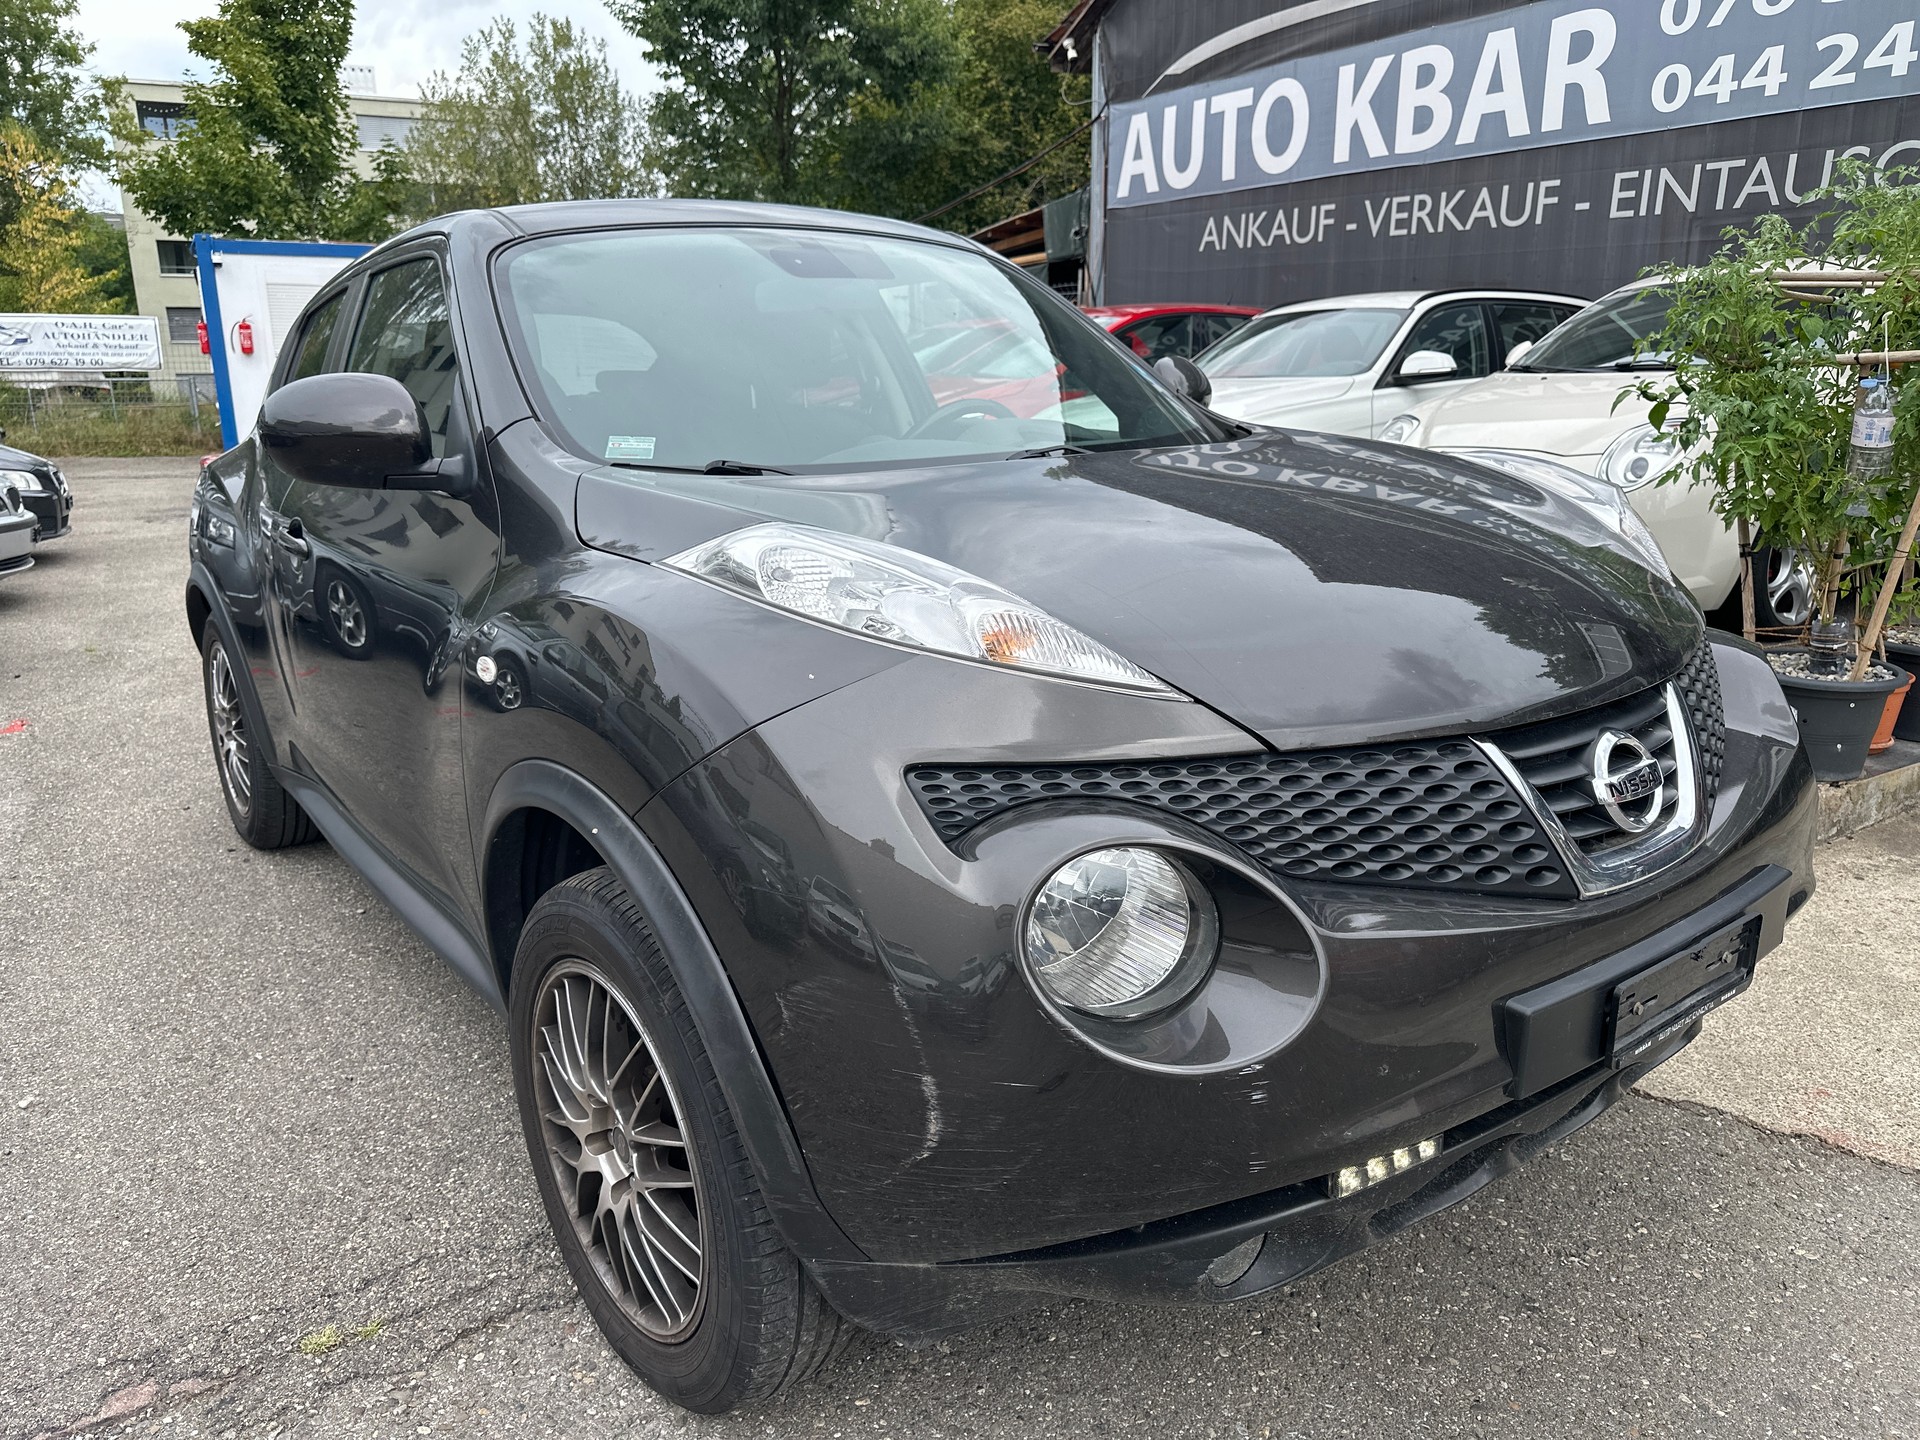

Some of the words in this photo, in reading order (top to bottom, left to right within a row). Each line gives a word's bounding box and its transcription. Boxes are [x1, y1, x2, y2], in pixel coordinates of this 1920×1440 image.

[1651, 44, 1788, 114] 044
[1117, 77, 1310, 198] AUTO
[1333, 8, 1617, 164] KBAR
[1199, 203, 1337, 252] ANKAUF
[1364, 179, 1562, 238] VERKAUF
[42, 331, 149, 342] AUTOHÄNDLER
[91, 342, 99, 350] &
[26, 357, 45, 366] 079
[50, 358, 69, 366] 627
[74, 358, 86, 366] 19
[90, 358, 104, 366] 00
[1609, 768, 1662, 798] NISSAN
